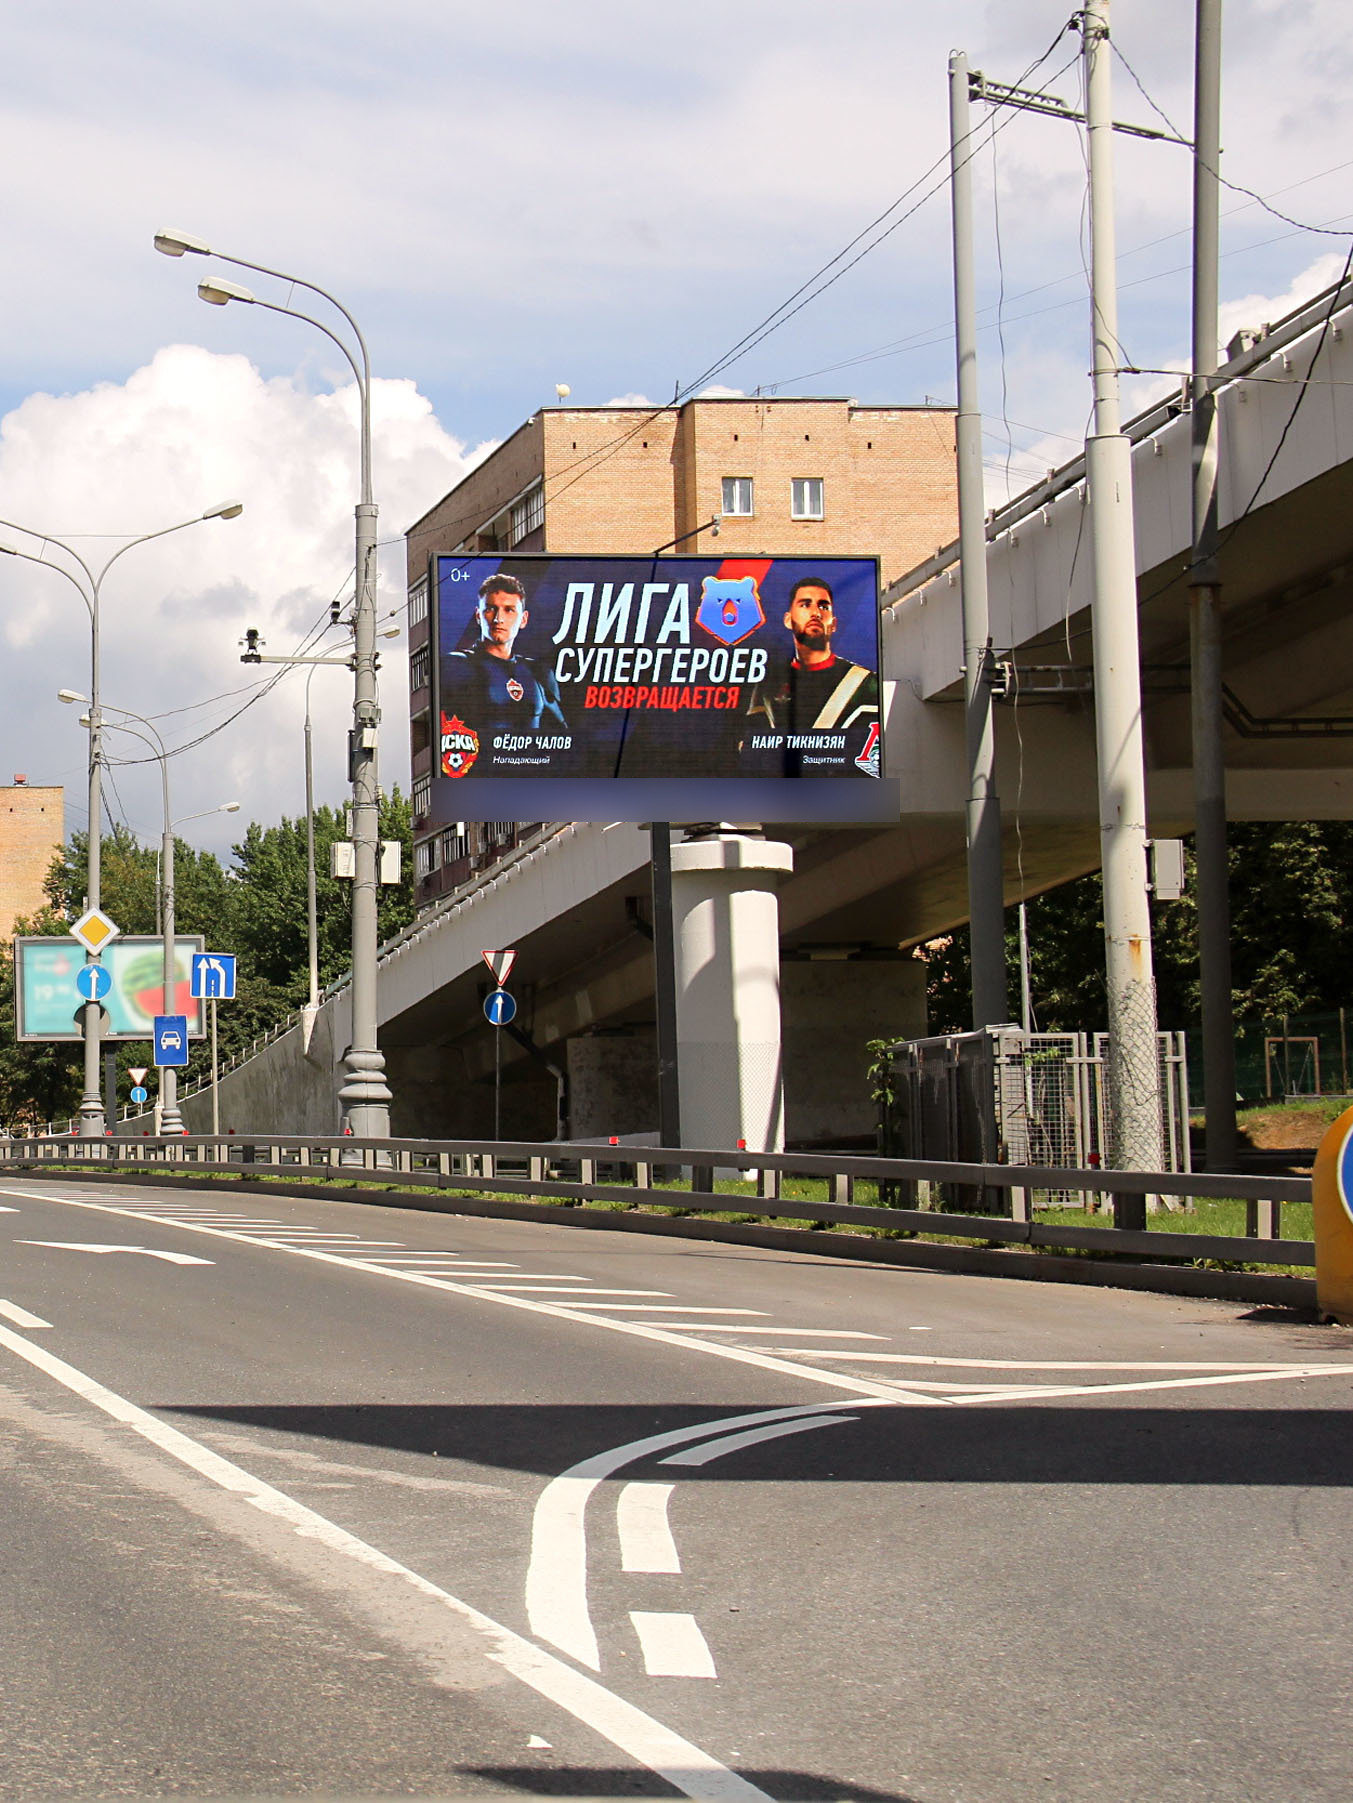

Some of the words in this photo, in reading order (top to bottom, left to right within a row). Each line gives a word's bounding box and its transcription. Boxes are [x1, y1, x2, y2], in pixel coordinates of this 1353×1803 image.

[451, 567, 471, 582] 0+
[552, 583, 691, 645] ЛИГА
[555, 648, 768, 683] СУПЕРГЕРОЕВ
[584, 685, 741, 712] ВОЗВРАЩАЕТСЯ
[493, 733, 532, 751] ФЁДОР
[535, 736, 572, 750] ЧАЛОВ
[751, 735, 784, 749] НАИР
[786, 735, 846, 749] ТИКНИЗЯН
